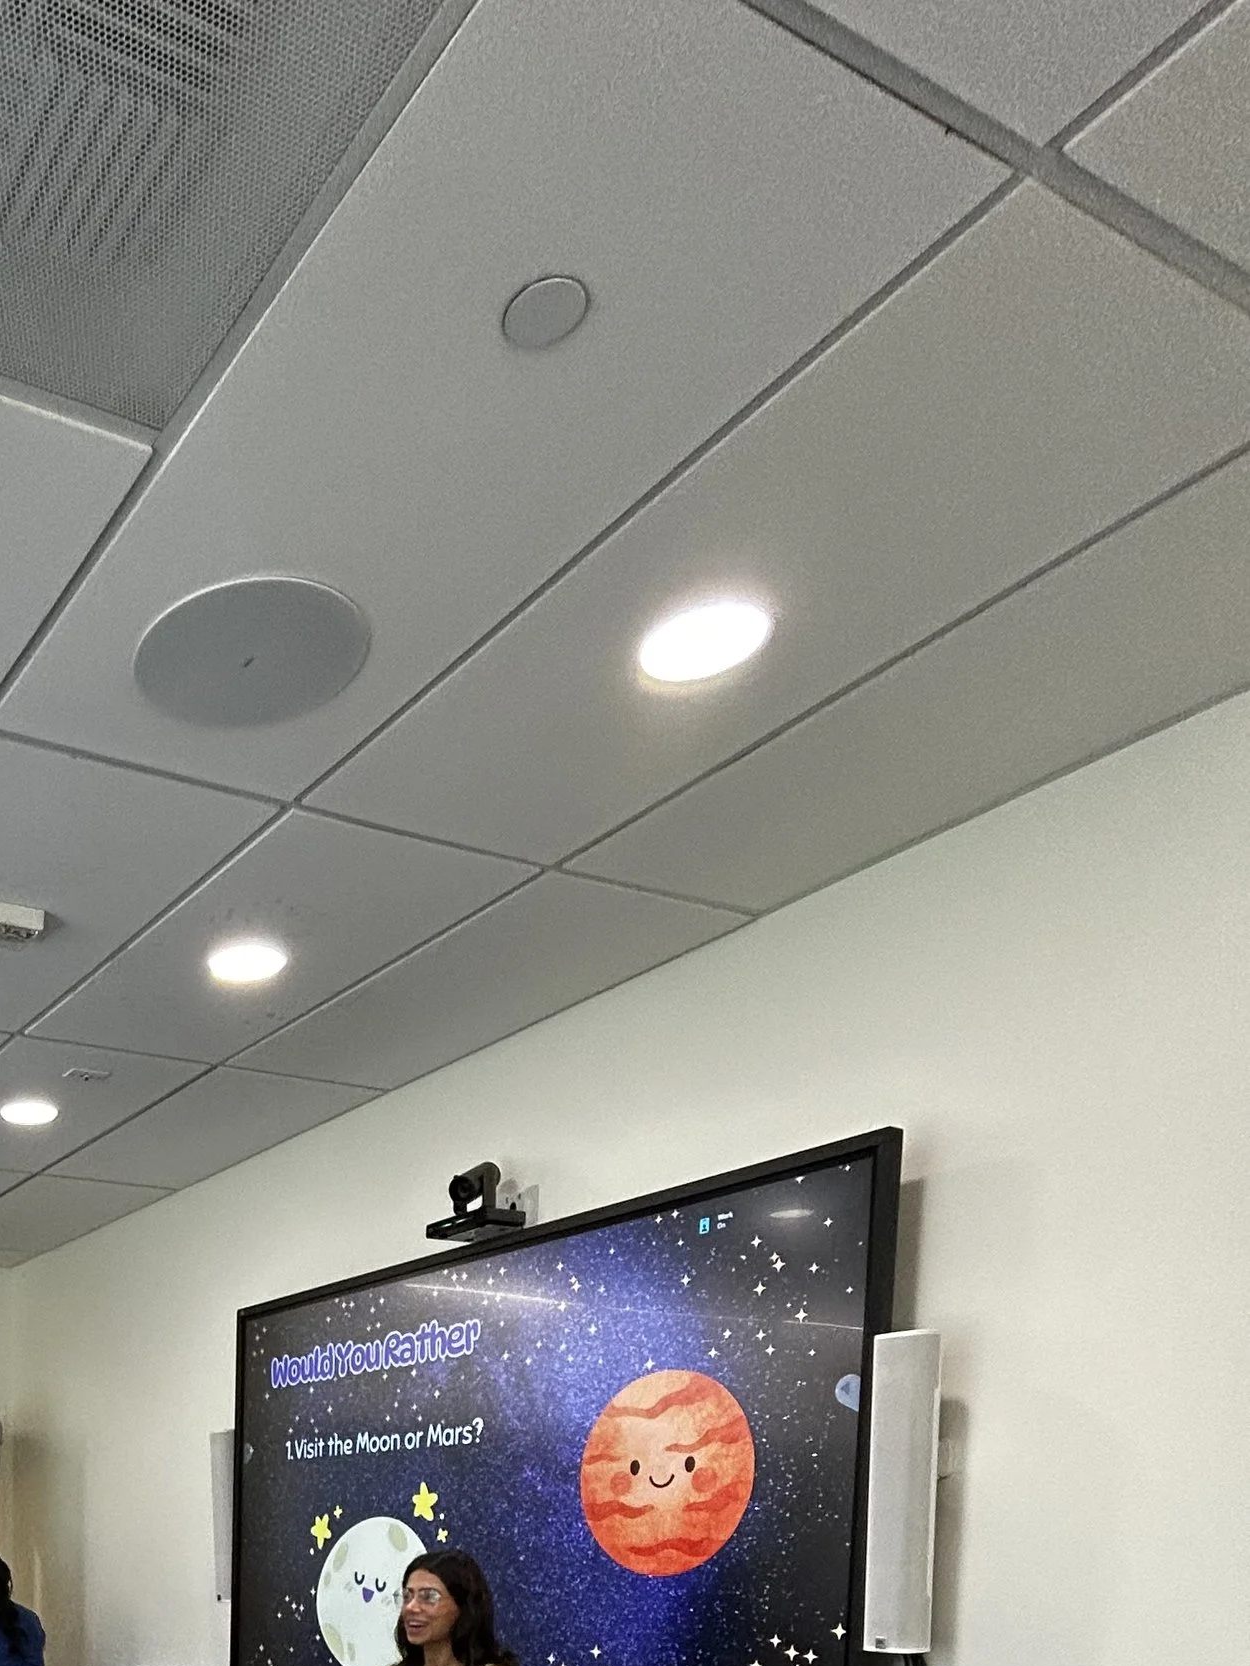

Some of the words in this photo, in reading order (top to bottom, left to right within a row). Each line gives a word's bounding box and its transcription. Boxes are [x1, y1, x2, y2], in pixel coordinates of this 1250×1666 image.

[271, 1343, 335, 1388] Would
[335, 1340, 382, 1377] You
[383, 1319, 482, 1369] Rather
[327, 1432, 353, 1457] the
[355, 1431, 401, 1454] Moon
[404, 1430, 424, 1450] or
[426, 1416, 485, 1448] Mars?
